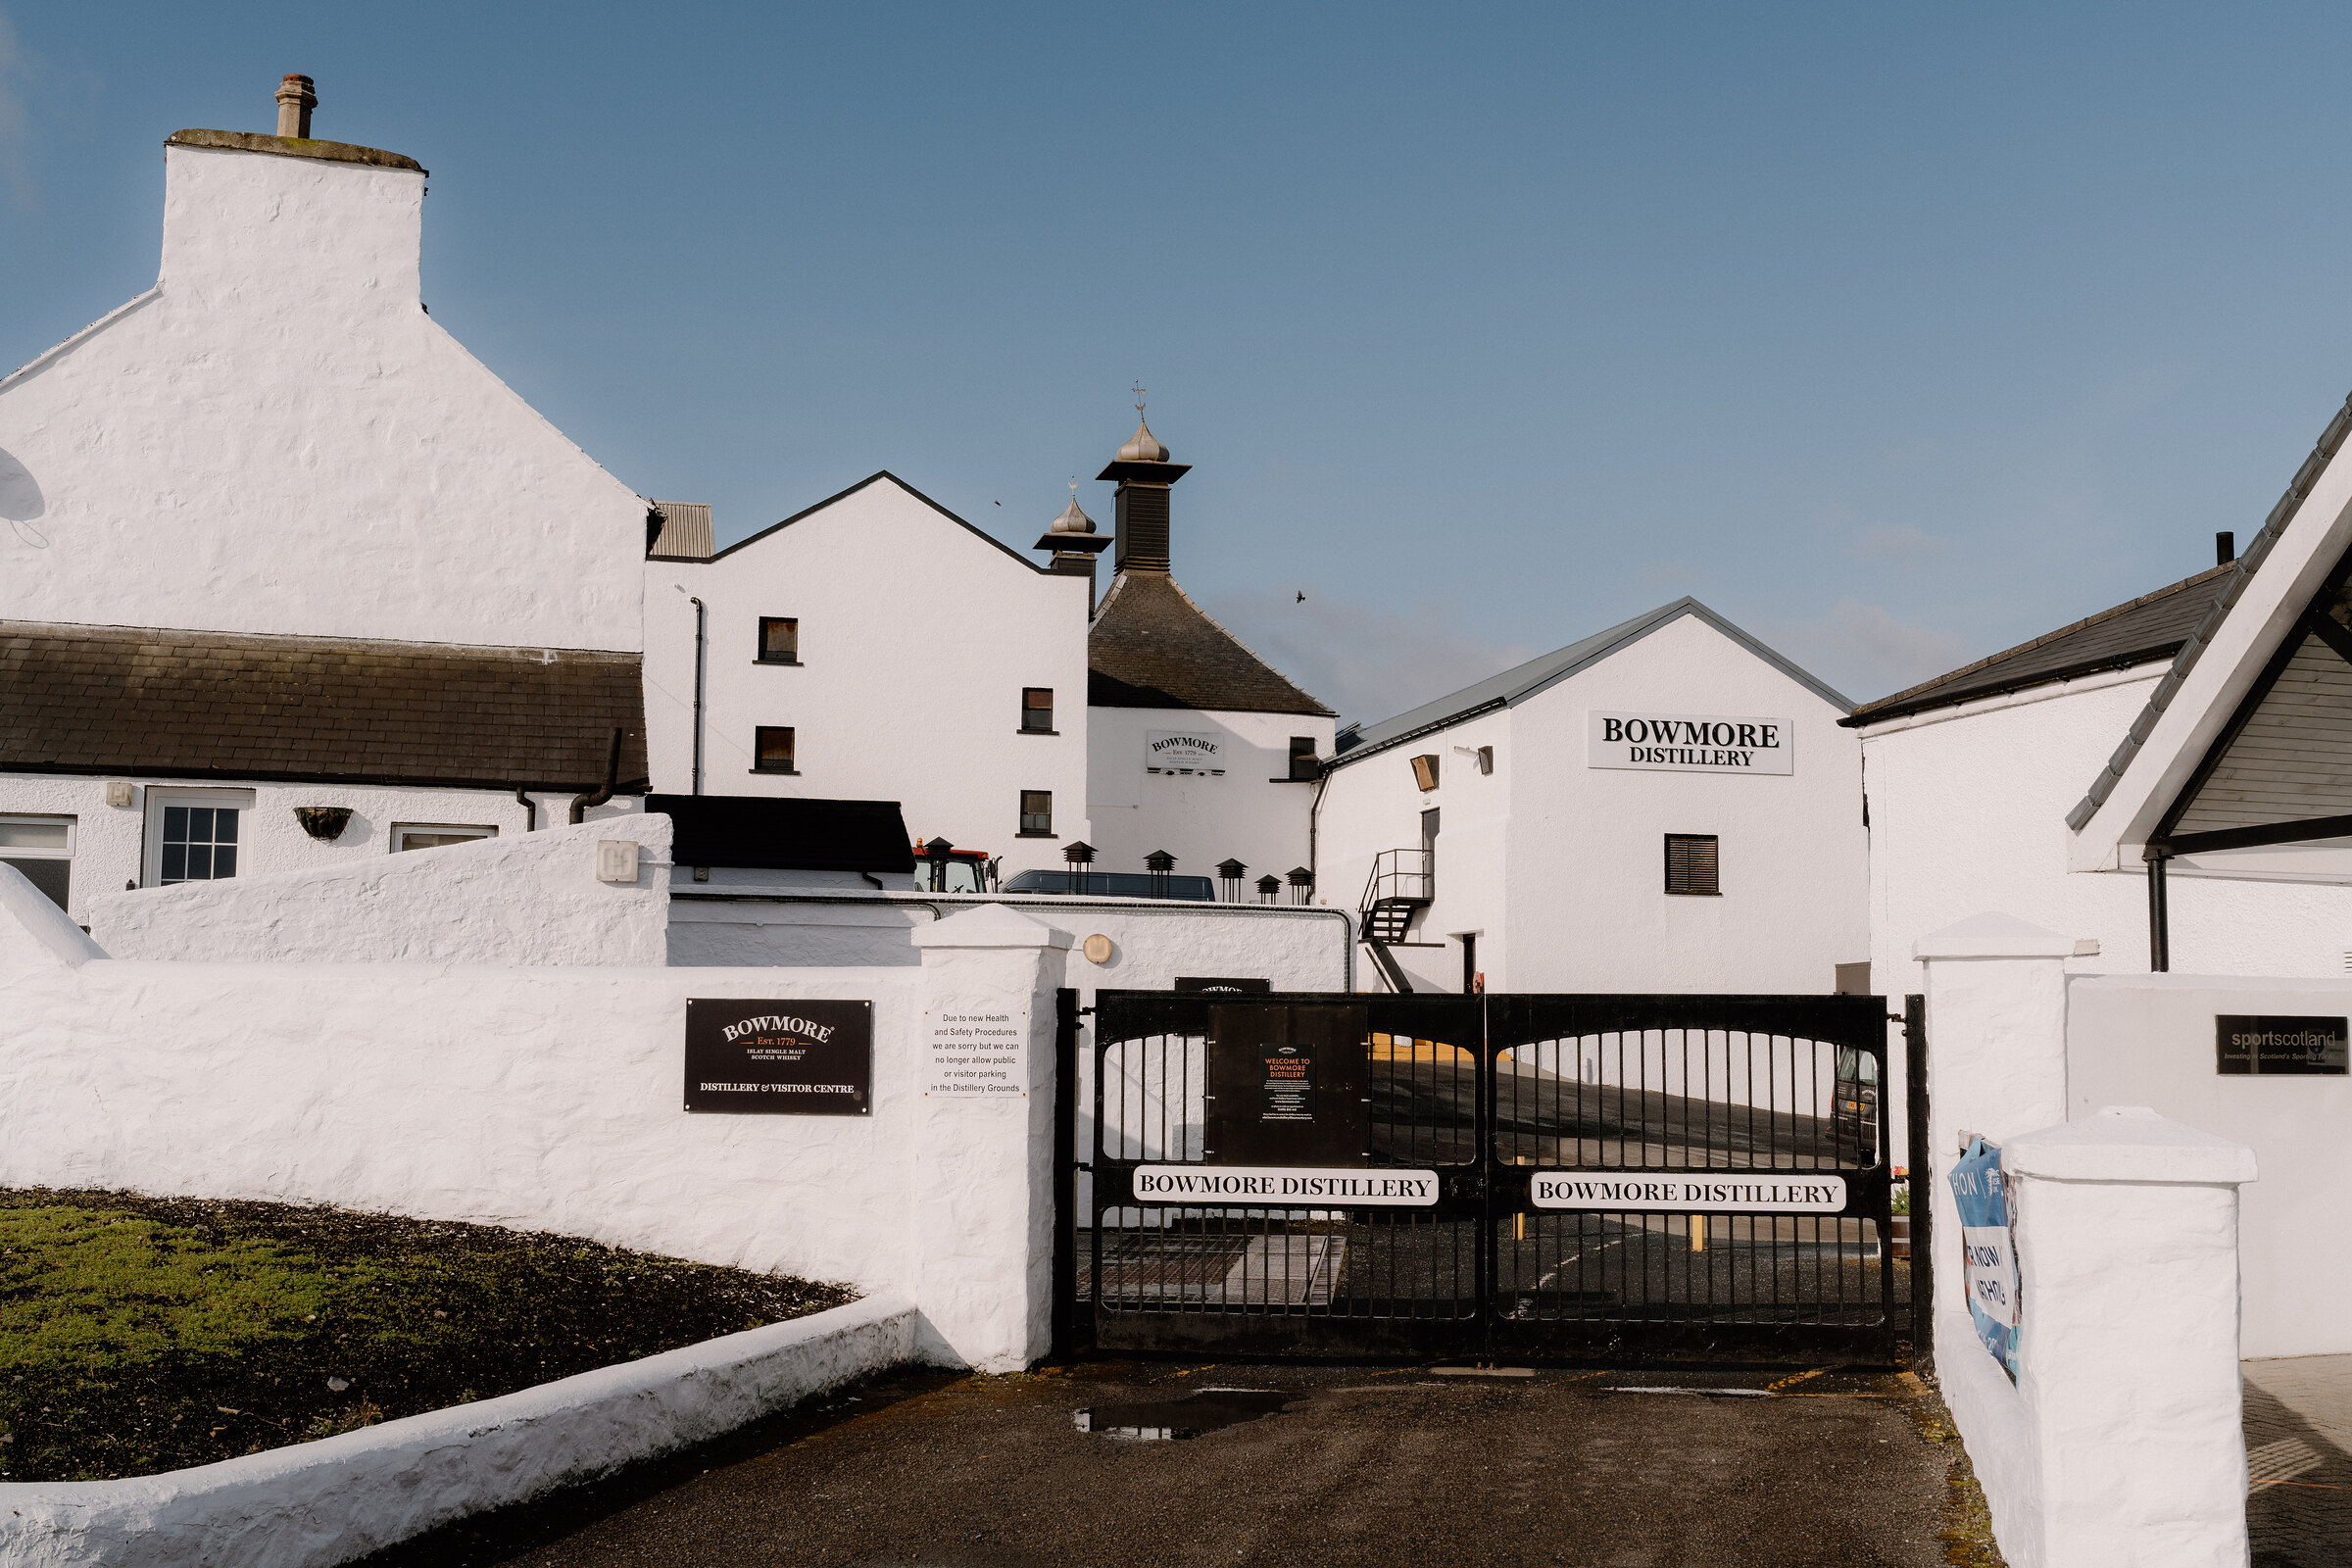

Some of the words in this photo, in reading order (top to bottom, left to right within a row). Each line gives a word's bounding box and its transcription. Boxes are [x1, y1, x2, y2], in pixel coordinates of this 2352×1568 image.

[1602, 717, 1780, 748] BOWMORE
[1152, 737, 1218, 755] BOWMORE
[1630, 747, 1754, 766] DISTILLERY
[943, 1013, 957, 1022] Due
[959, 1013, 966, 1022] to
[985, 1013, 1009, 1022] Health
[934, 1027, 949, 1036] and
[950, 1027, 973, 1038] Safety
[974, 1027, 1018, 1036] Procedures
[776, 1037, 796, 1047] 1779
[2231, 1030, 2335, 1050] sportscotland
[957, 1043, 978, 1052] sorry
[979, 1042, 992, 1051] but
[946, 1055, 970, 1066] longer
[971, 1055, 992, 1064] allow
[993, 1055, 1016, 1065] public
[2224, 1053, 2251, 1061] Investing
[953, 1069, 977, 1078] visitor
[978, 1069, 1006, 1080] parking
[700, 1082, 760, 1092] DISTILLERY
[760, 1084, 770, 1093] &
[770, 1084, 812, 1093] VISITOR
[813, 1084, 855, 1094] CENTRE
[930, 1083, 938, 1092] in
[939, 1083, 952, 1092] the
[953, 1083, 986, 1094] Distillery
[987, 1083, 1020, 1093] Grounds
[1139, 1174, 1275, 1195] BOWMORE
[1281, 1177, 1432, 1198] DISTILLERY
[1538, 1181, 1678, 1201] BOWMORE
[1683, 1184, 1838, 1203] DISTILLERY
